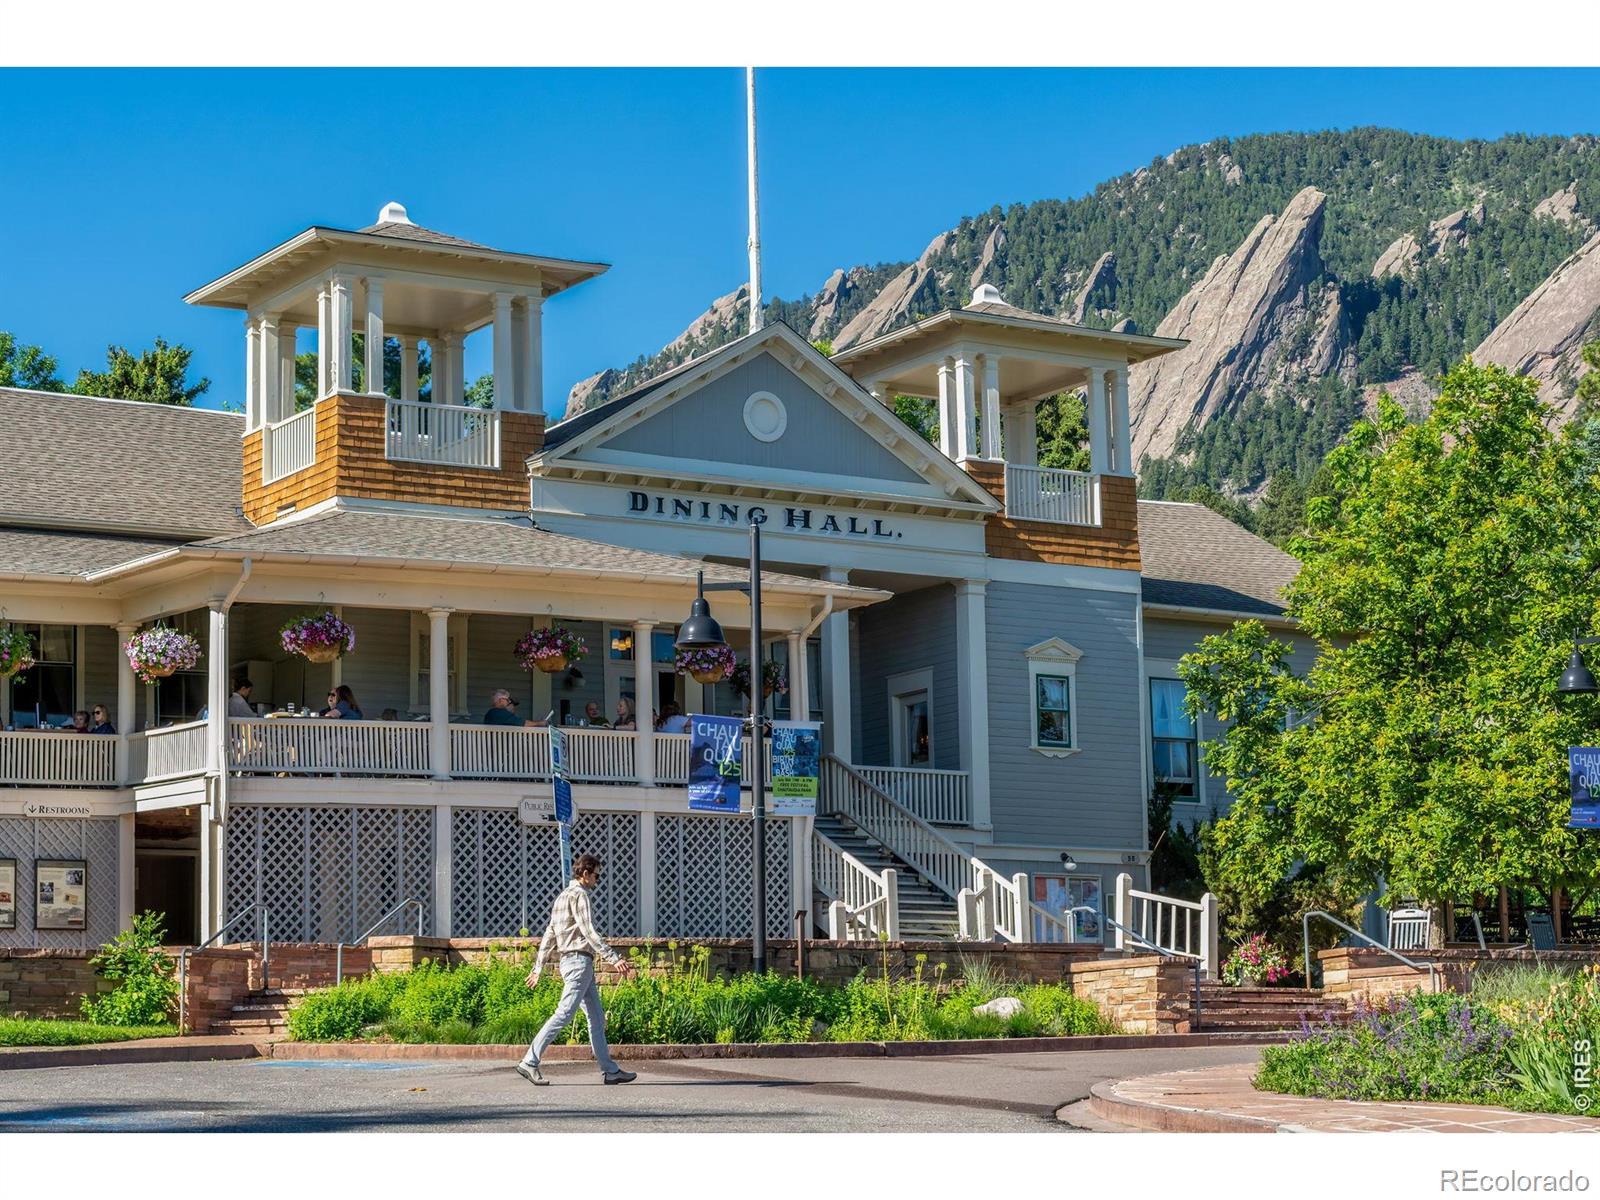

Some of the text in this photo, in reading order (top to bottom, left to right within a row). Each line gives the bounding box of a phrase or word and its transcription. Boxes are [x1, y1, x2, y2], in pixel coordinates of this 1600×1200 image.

[629, 490, 903, 538] DINING HALL.
[697, 722, 739, 738] CHAU
[713, 735, 742, 751] TAU
[1573, 753, 1600, 766] CHAU
[1579, 775, 1600, 789] QUA
[1590, 785, 1600, 798] 12
[39, 804, 90, 814] RESTROOMS
